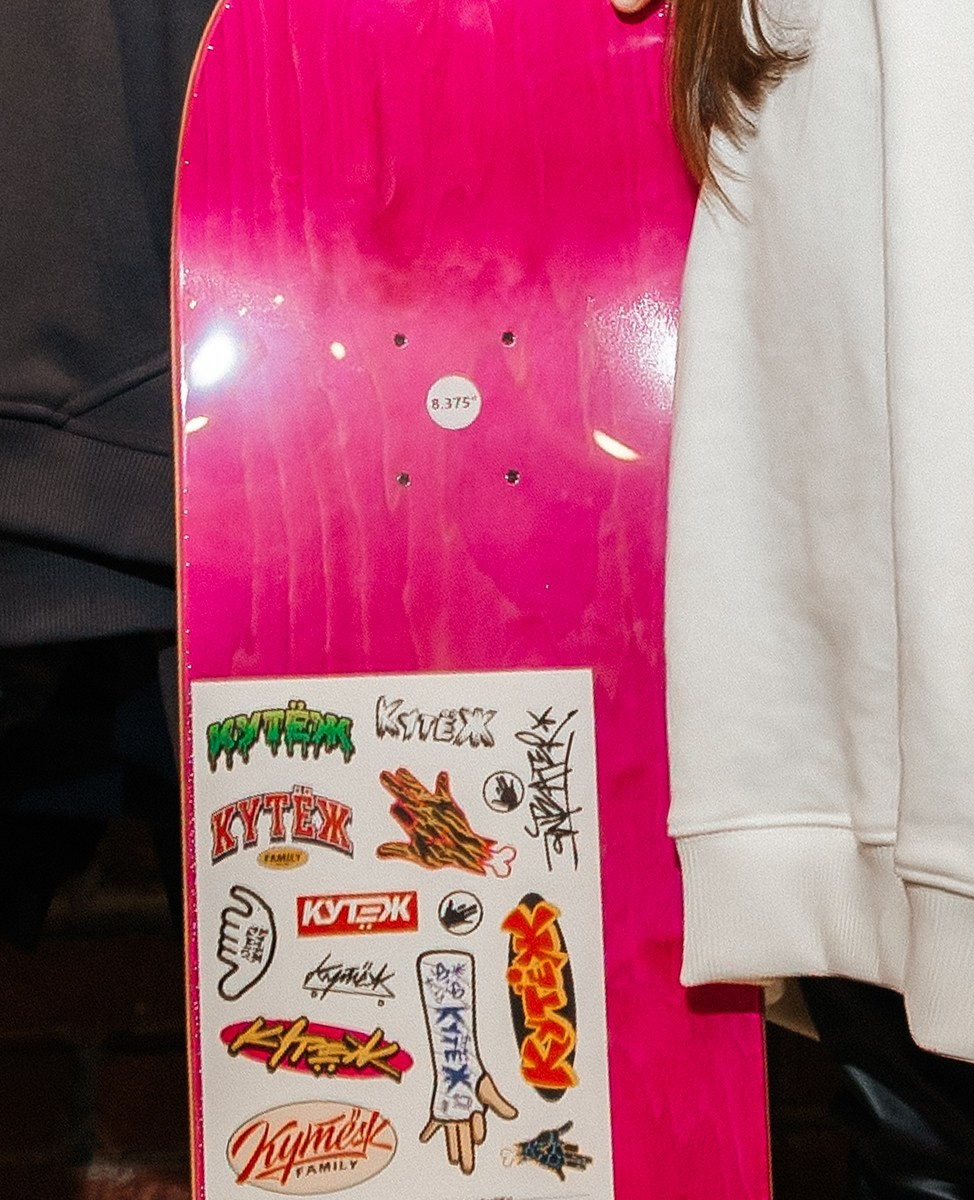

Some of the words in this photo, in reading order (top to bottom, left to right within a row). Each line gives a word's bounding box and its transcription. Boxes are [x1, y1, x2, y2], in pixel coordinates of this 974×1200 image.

[206, 699, 356, 773] КУТЁЖ
[210, 783, 354, 866] КУТЁЖ
[501, 902, 580, 1089] КУТЁЖ
[295, 1159, 359, 1179] FAMILY
